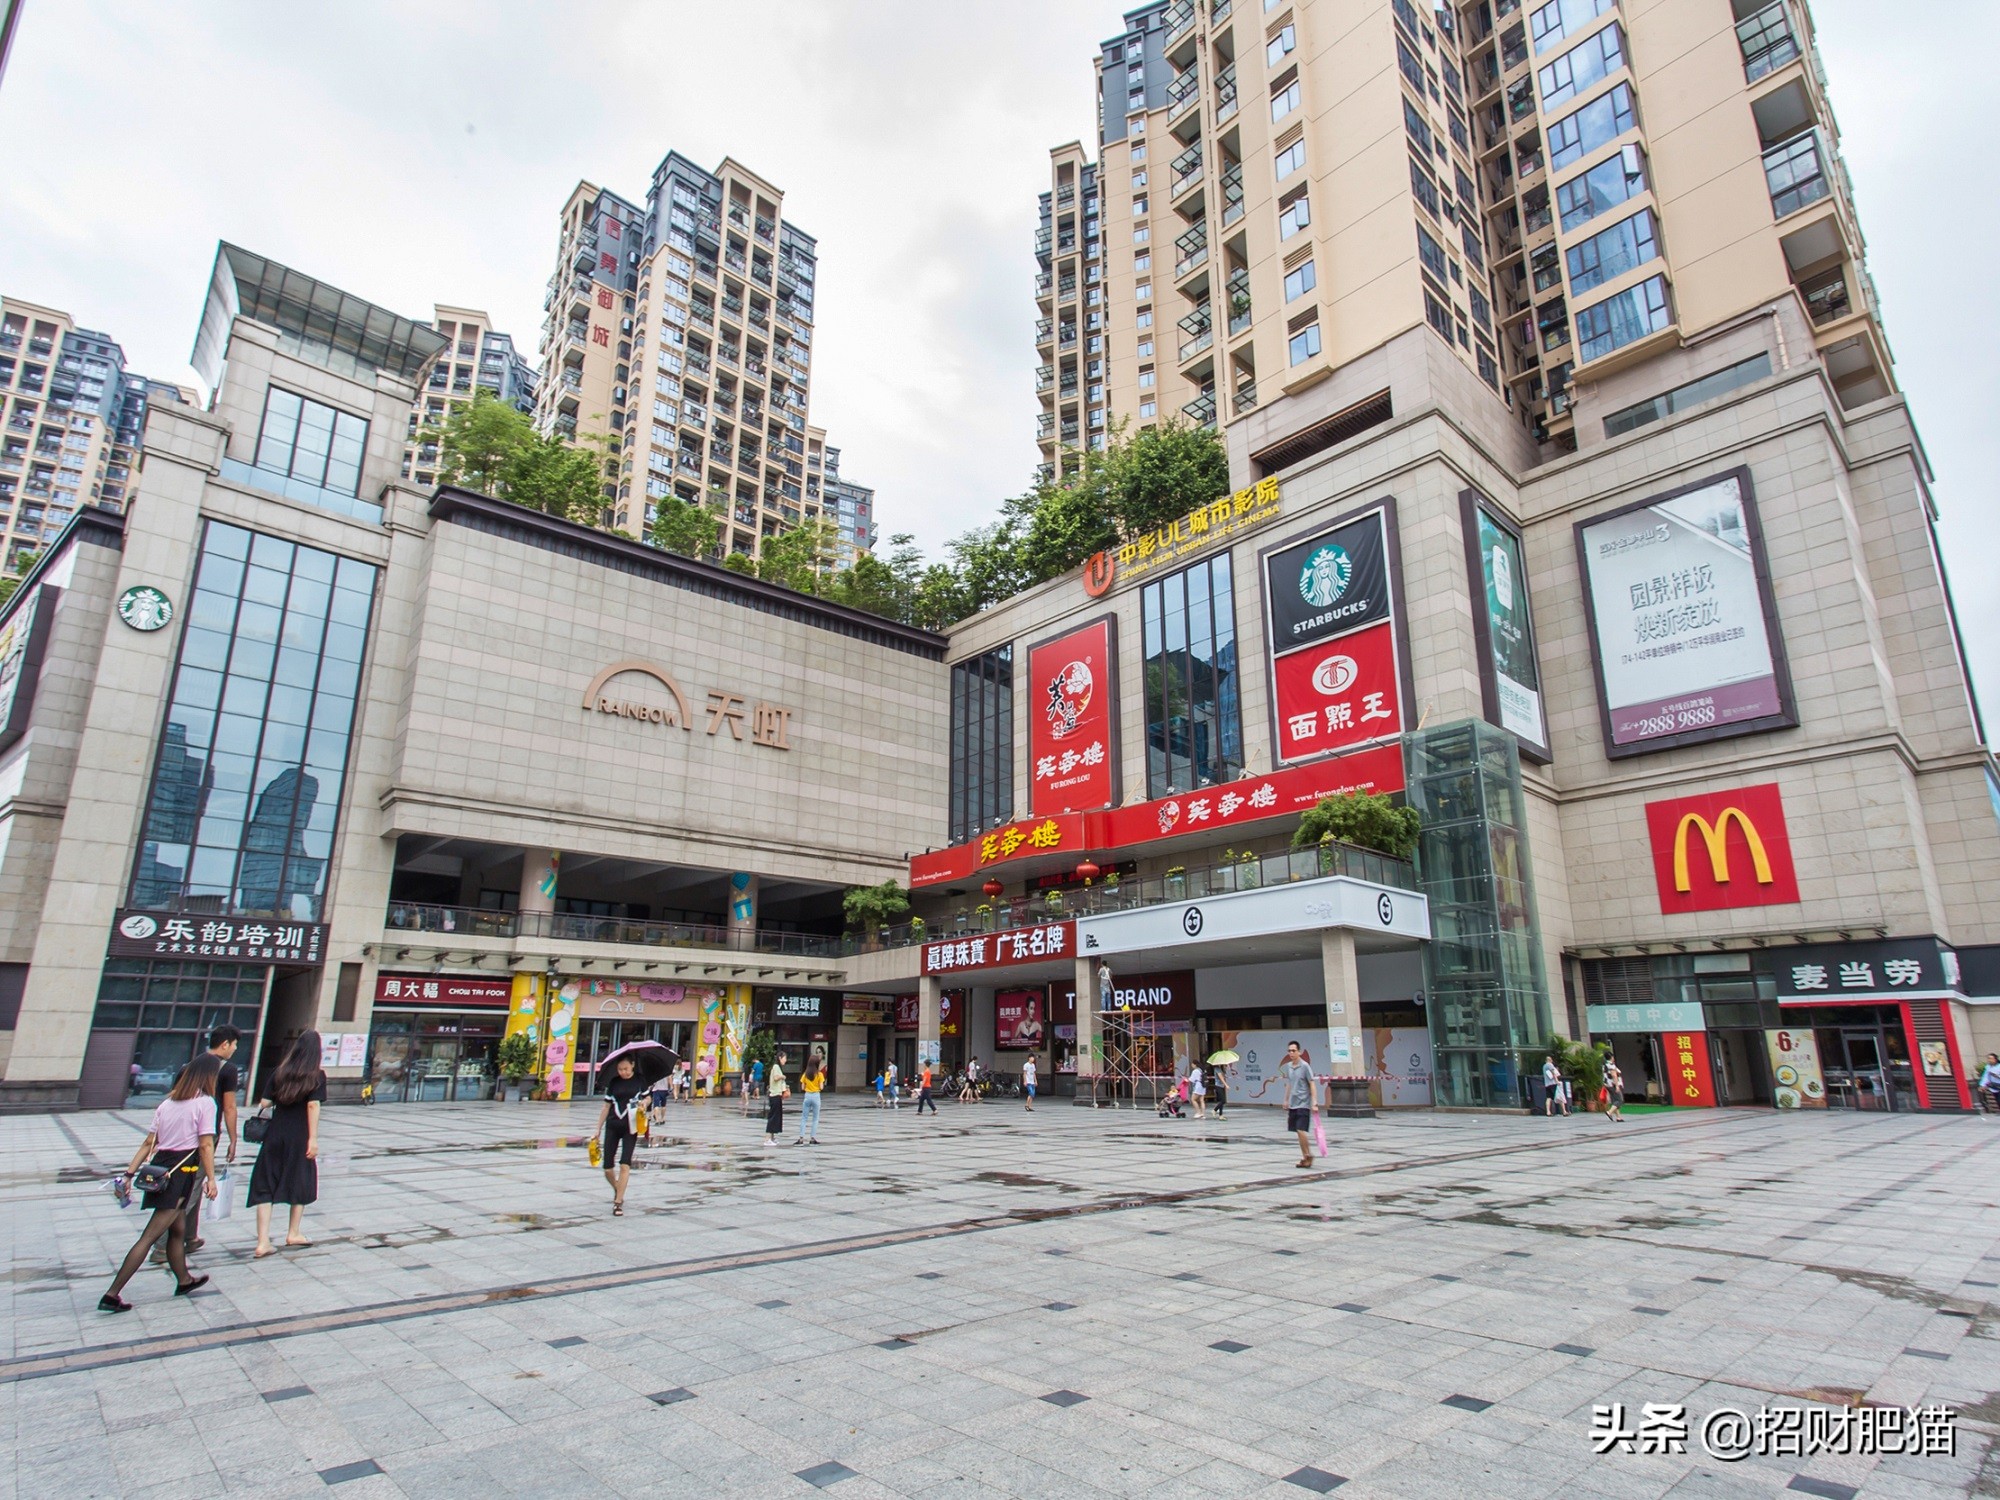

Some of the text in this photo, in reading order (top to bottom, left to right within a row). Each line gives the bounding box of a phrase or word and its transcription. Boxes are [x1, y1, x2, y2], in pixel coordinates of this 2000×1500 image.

[1119, 504, 1281, 581] CHINA FILM URBAN LIFE CINEMA
[1293, 600, 1368, 634] STARBUCKS
[598, 697, 679, 727] RAINBOW
[706, 690, 792, 751] 天虹
[1287, 692, 1393, 741] 面點王
[1639, 714, 1675, 736] 2888
[1677, 706, 1716, 729] 9888
[1036, 741, 1105, 781] 芙蓉楼
[1077, 773, 1091, 784] LOU
[1187, 783, 1278, 824] 芙蓉楼
[980, 820, 1063, 865] 芙蓉楼
[154, 941, 240, 956] 艺术文化培训
[159, 919, 305, 948] 乐韵培训
[995, 925, 1065, 962] 广东名牌
[384, 980, 439, 999] 周大福
[448, 988, 470, 996] CHOW
[485, 989, 506, 997] FOOK
[1792, 959, 1922, 991] 麦当劳
[624, 1001, 646, 1013] 天虹
[777, 996, 820, 1011] 六福珠寶
[1114, 986, 1172, 1008] BRAND
[1605, 1007, 1683, 1023] 招商中心
[1777, 1030, 1792, 1052] 6
[1676, 1035, 1700, 1098] 招商中心
